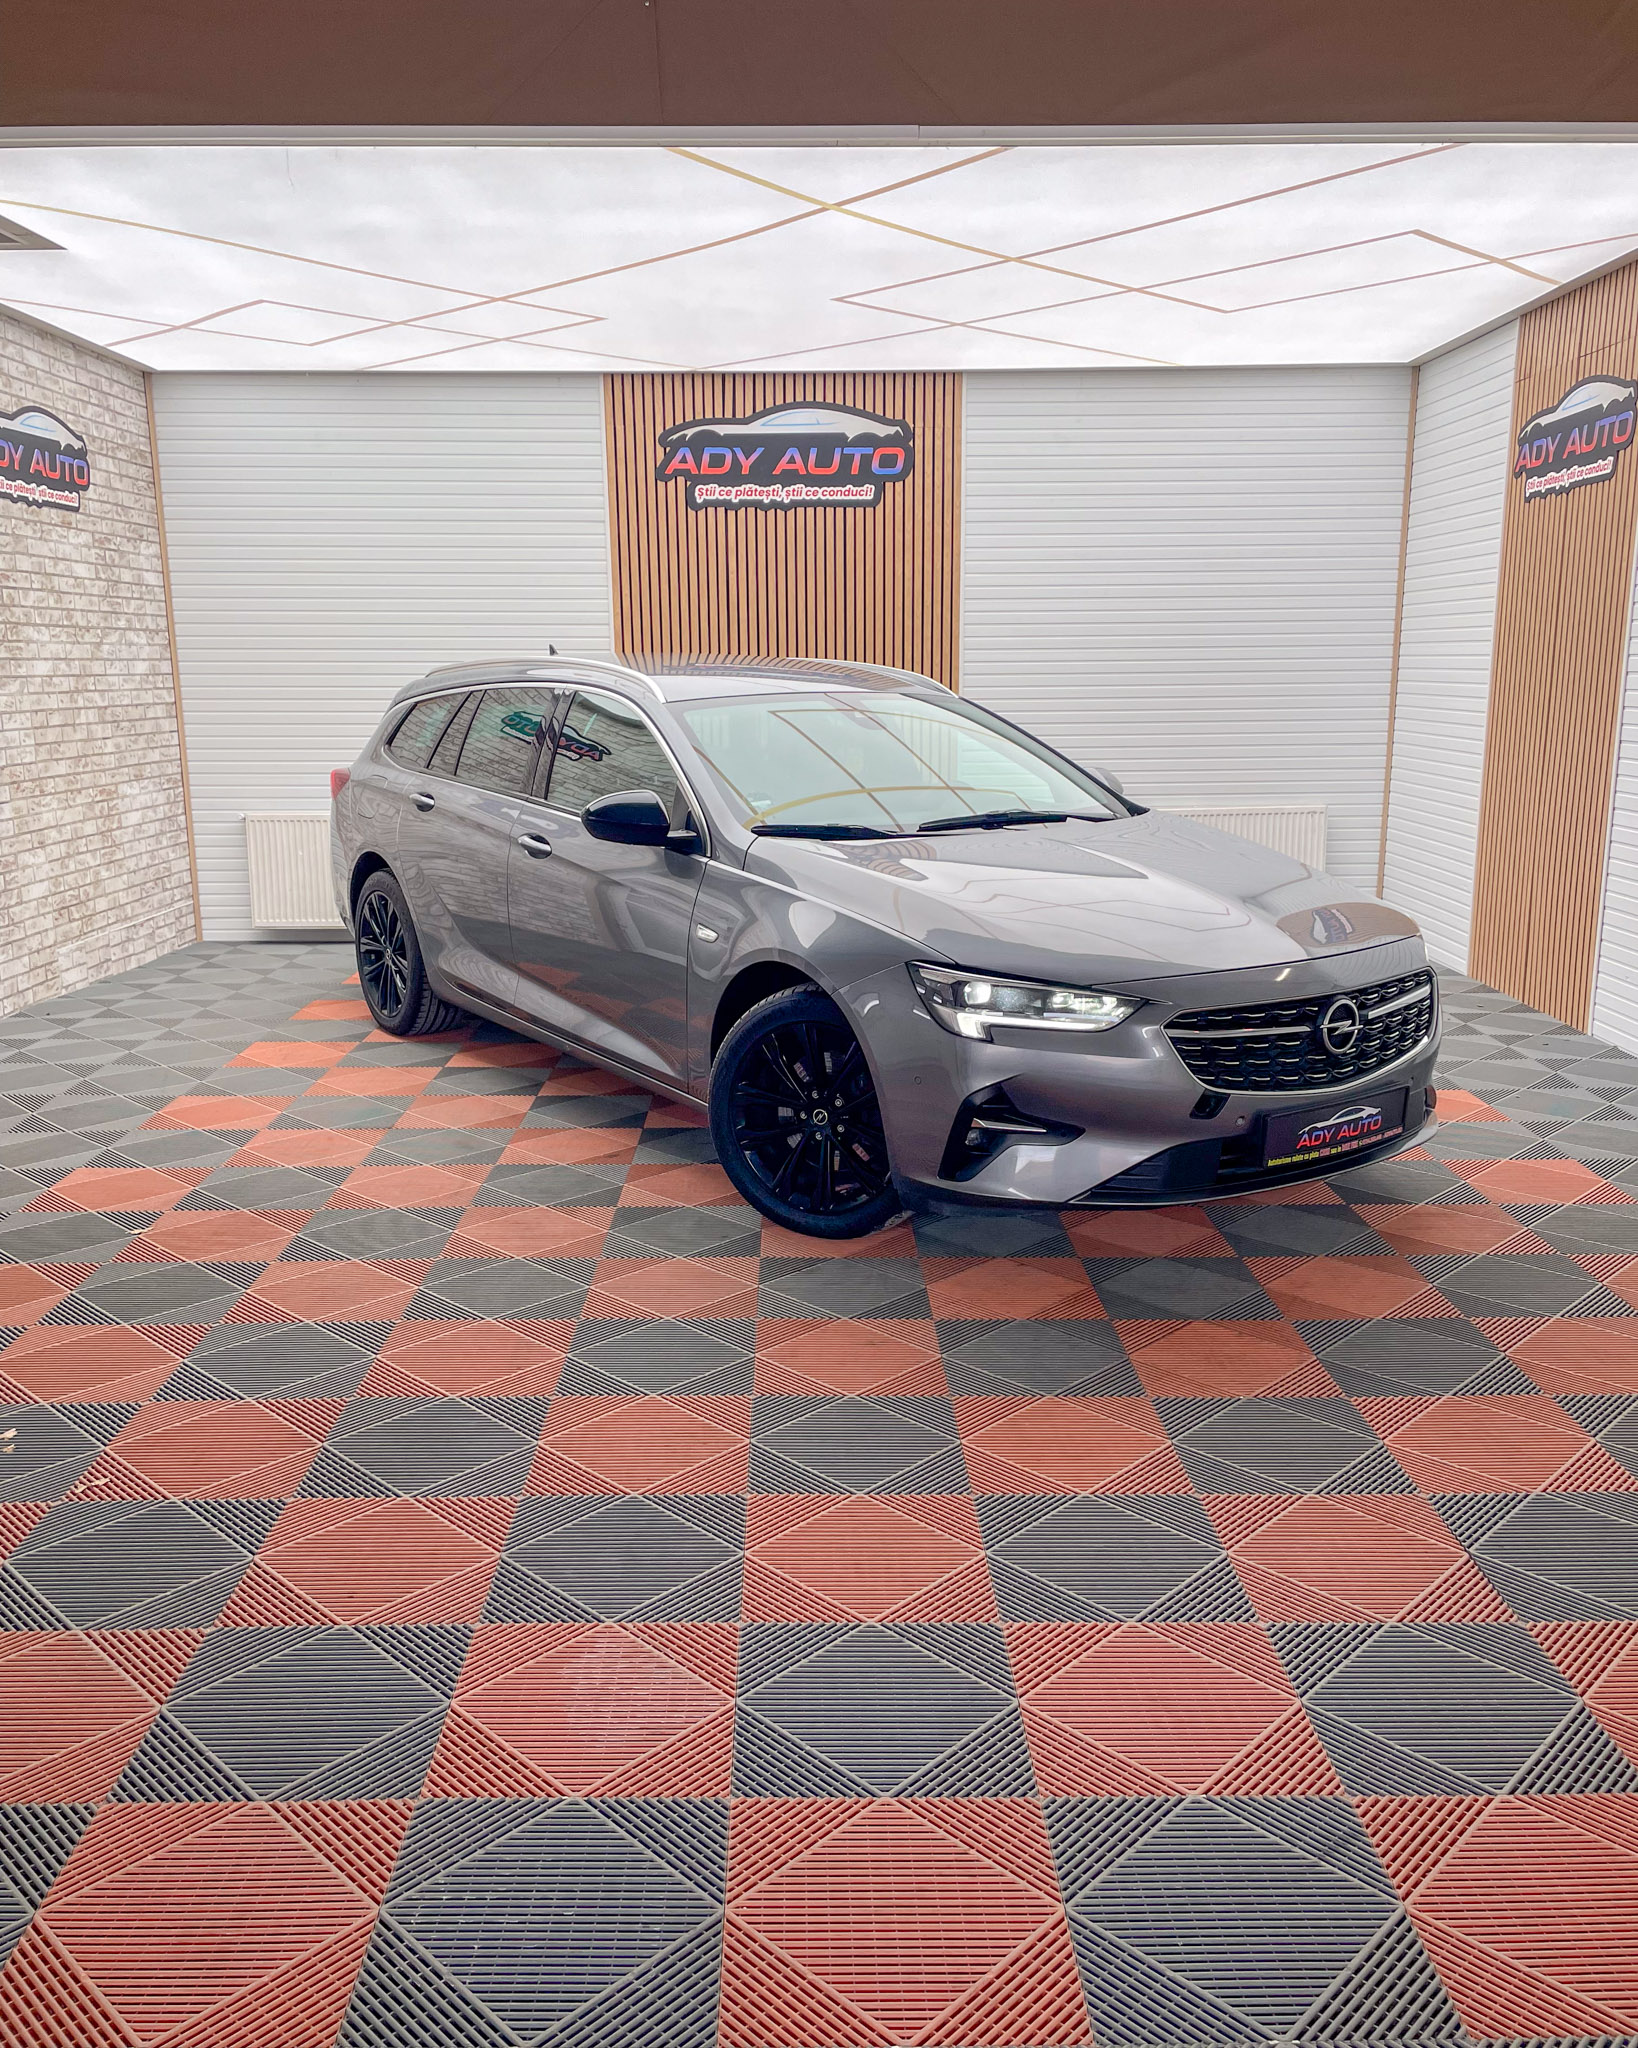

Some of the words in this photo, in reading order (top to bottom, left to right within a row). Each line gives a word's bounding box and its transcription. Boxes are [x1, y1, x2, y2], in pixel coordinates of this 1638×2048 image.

[1515, 433, 1562, 473] ADY
[1562, 411, 1633, 459] AUTO
[30, 448, 89, 486] AUTO
[665, 447, 764, 475] ADY
[772, 447, 905, 475] AUTO
[697, 486, 716, 500] Știi
[719, 489, 732, 497] ce
[734, 486, 783, 500] plătești,
[785, 486, 803, 500] știi
[805, 489, 819, 497] ce
[821, 486, 873, 497] conduci!
[1296, 1127, 1336, 1149] ADY
[1336, 1115, 1382, 1140] AUTO
